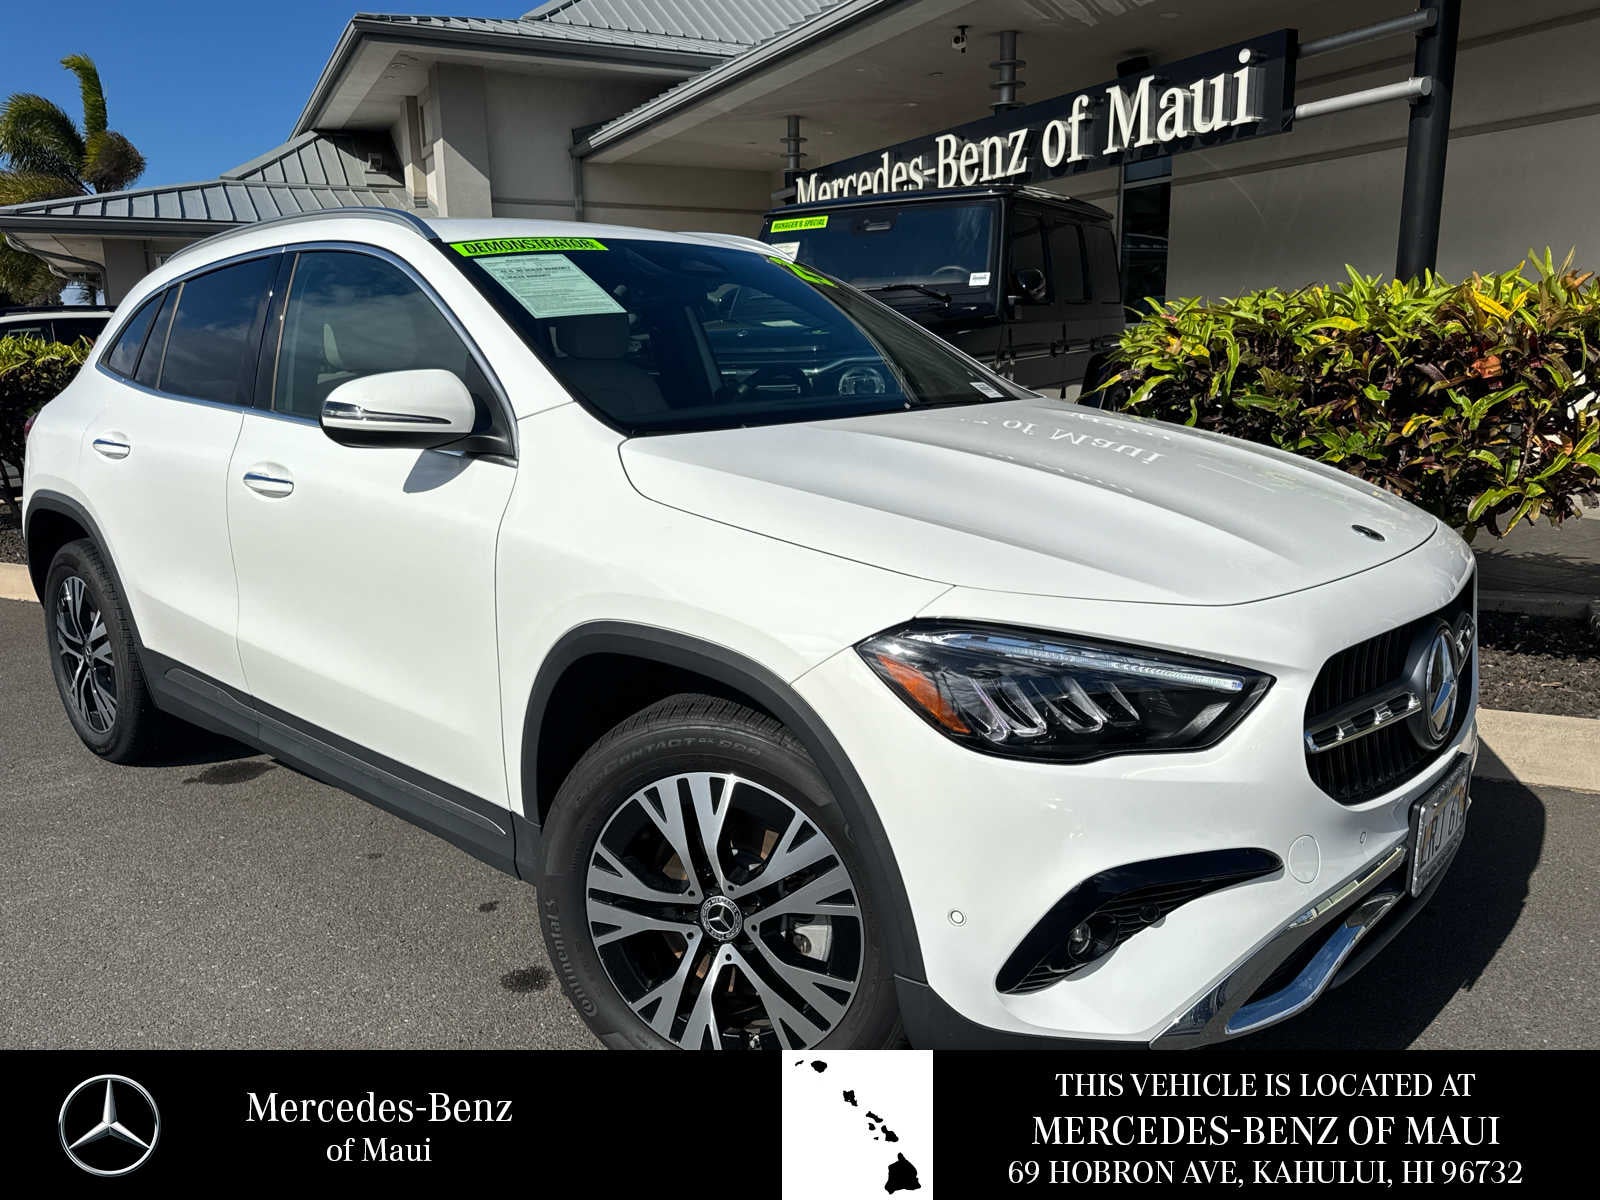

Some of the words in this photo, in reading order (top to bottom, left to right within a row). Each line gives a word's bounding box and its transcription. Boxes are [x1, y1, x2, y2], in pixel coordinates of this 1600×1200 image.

[796, 127, 1029, 204] Mercedes-Benz
[1041, 94, 1090, 169] of
[1102, 47, 1254, 156] Maui
[462, 238, 595, 254] DEMONSTRATOR
